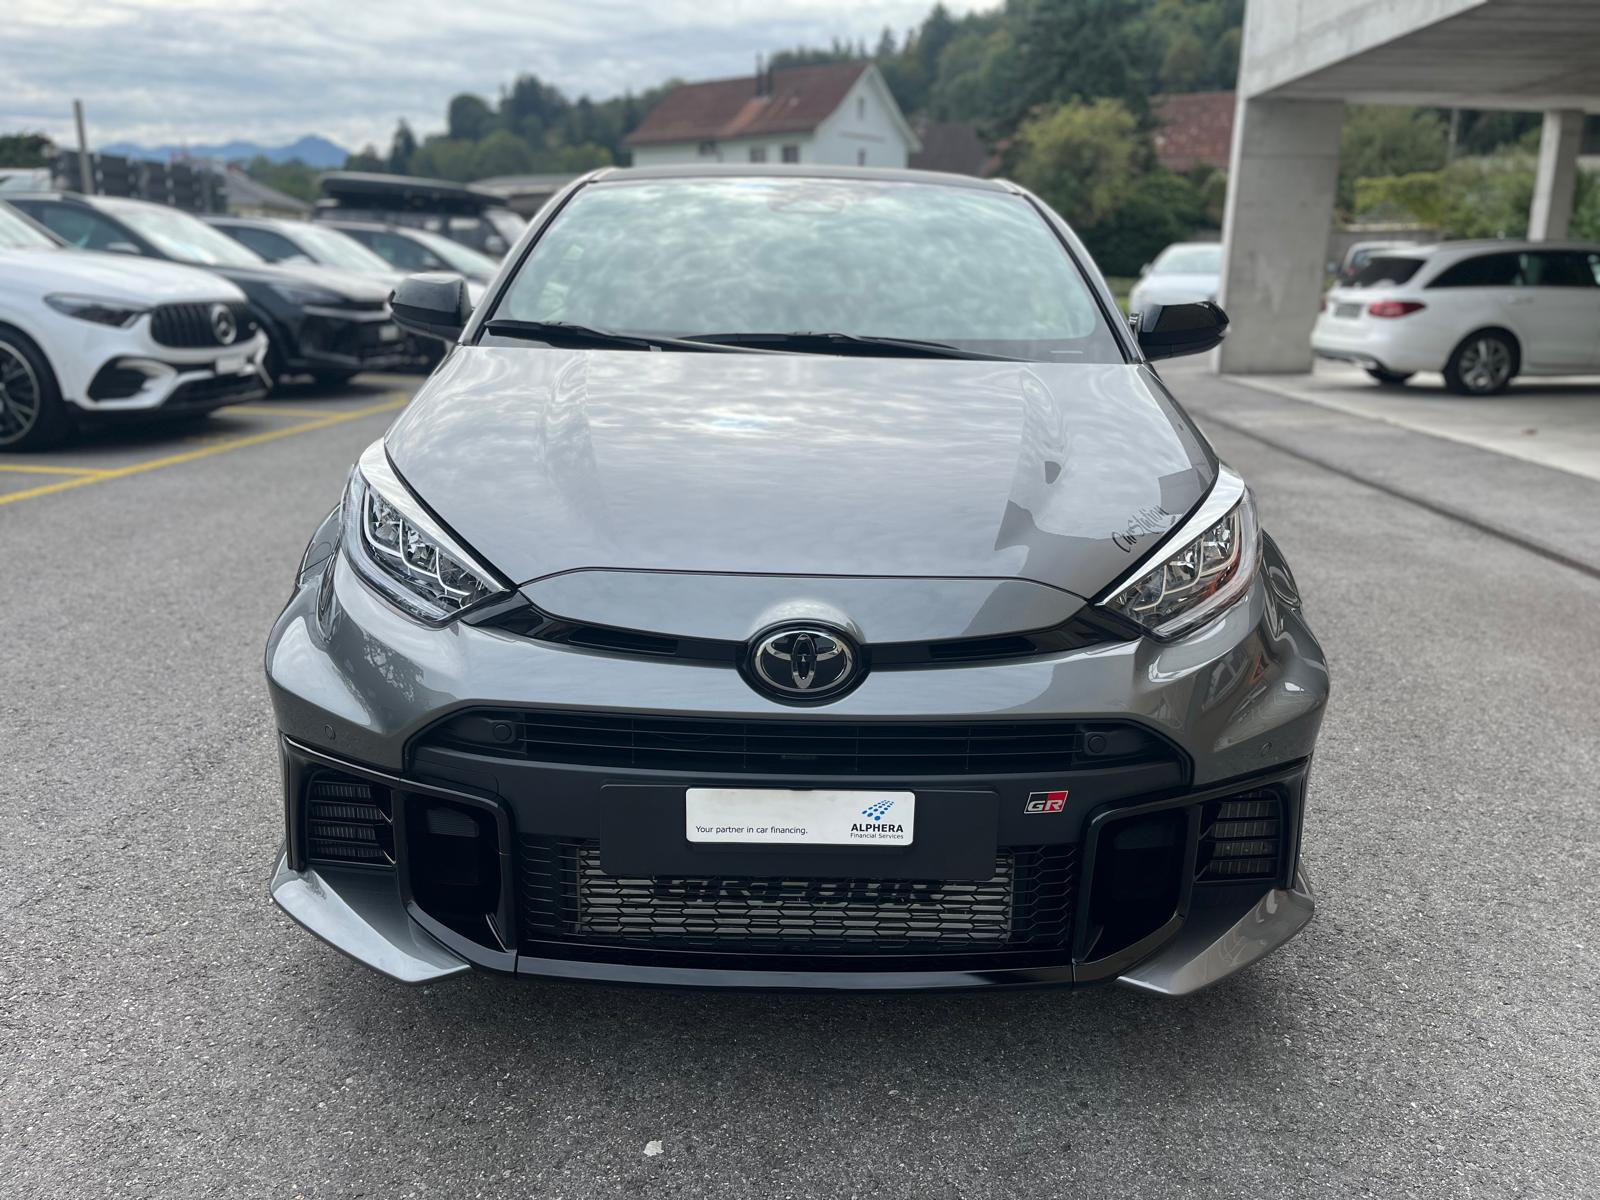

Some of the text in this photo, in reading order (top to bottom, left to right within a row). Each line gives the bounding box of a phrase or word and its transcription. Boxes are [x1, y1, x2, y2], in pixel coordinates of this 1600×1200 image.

[1027, 799, 1064, 812] GR
[695, 825, 713, 833] Your
[716, 826, 744, 835] partner
[770, 826, 808, 836] financing.
[850, 823, 904, 833] ALPHERA
